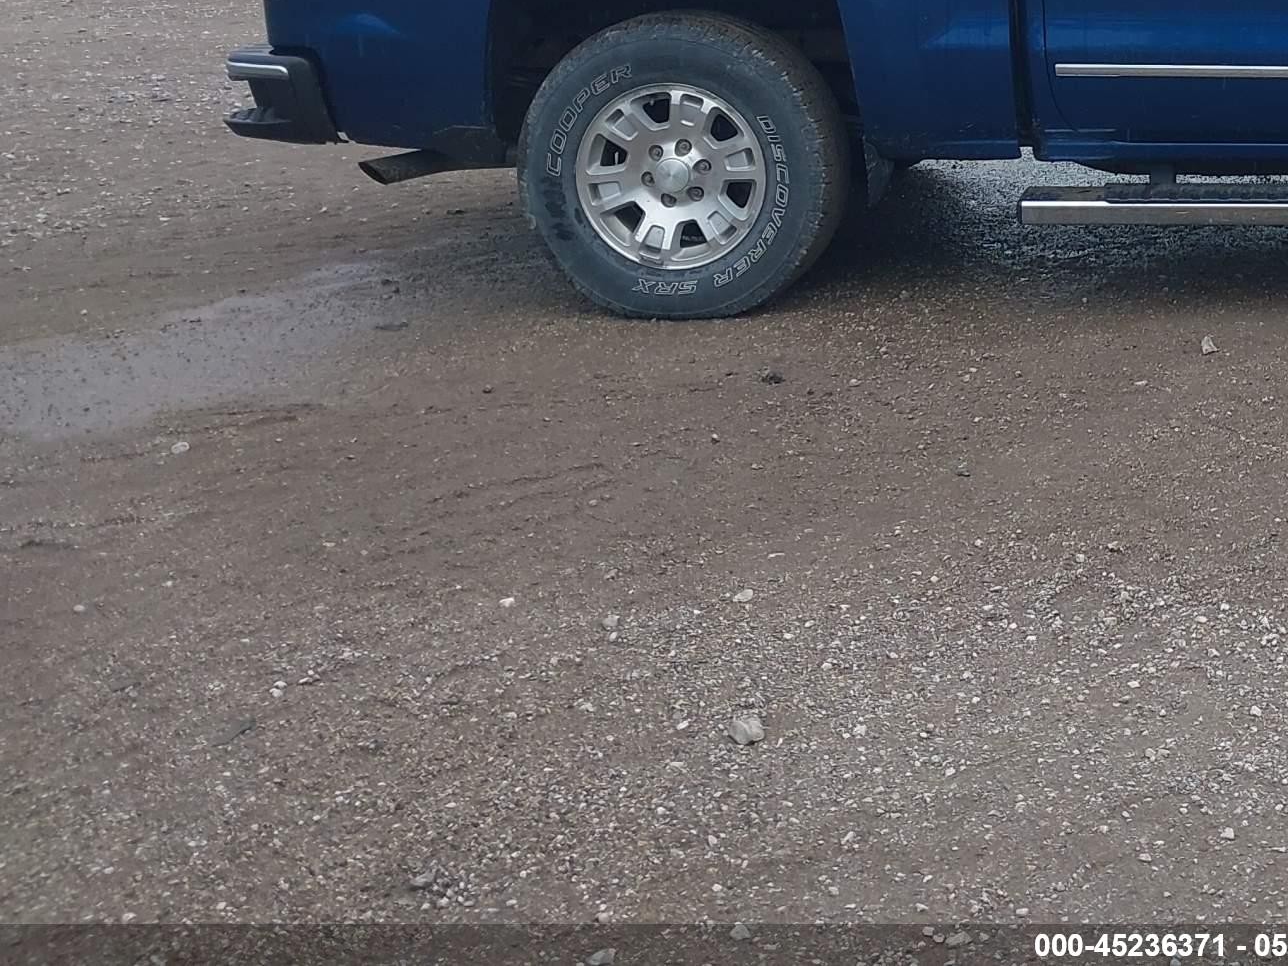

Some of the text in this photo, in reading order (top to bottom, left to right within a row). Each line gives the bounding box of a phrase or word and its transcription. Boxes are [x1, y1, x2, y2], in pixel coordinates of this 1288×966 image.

[546, 63, 789, 295] COOPER DISCOVERER SRX
